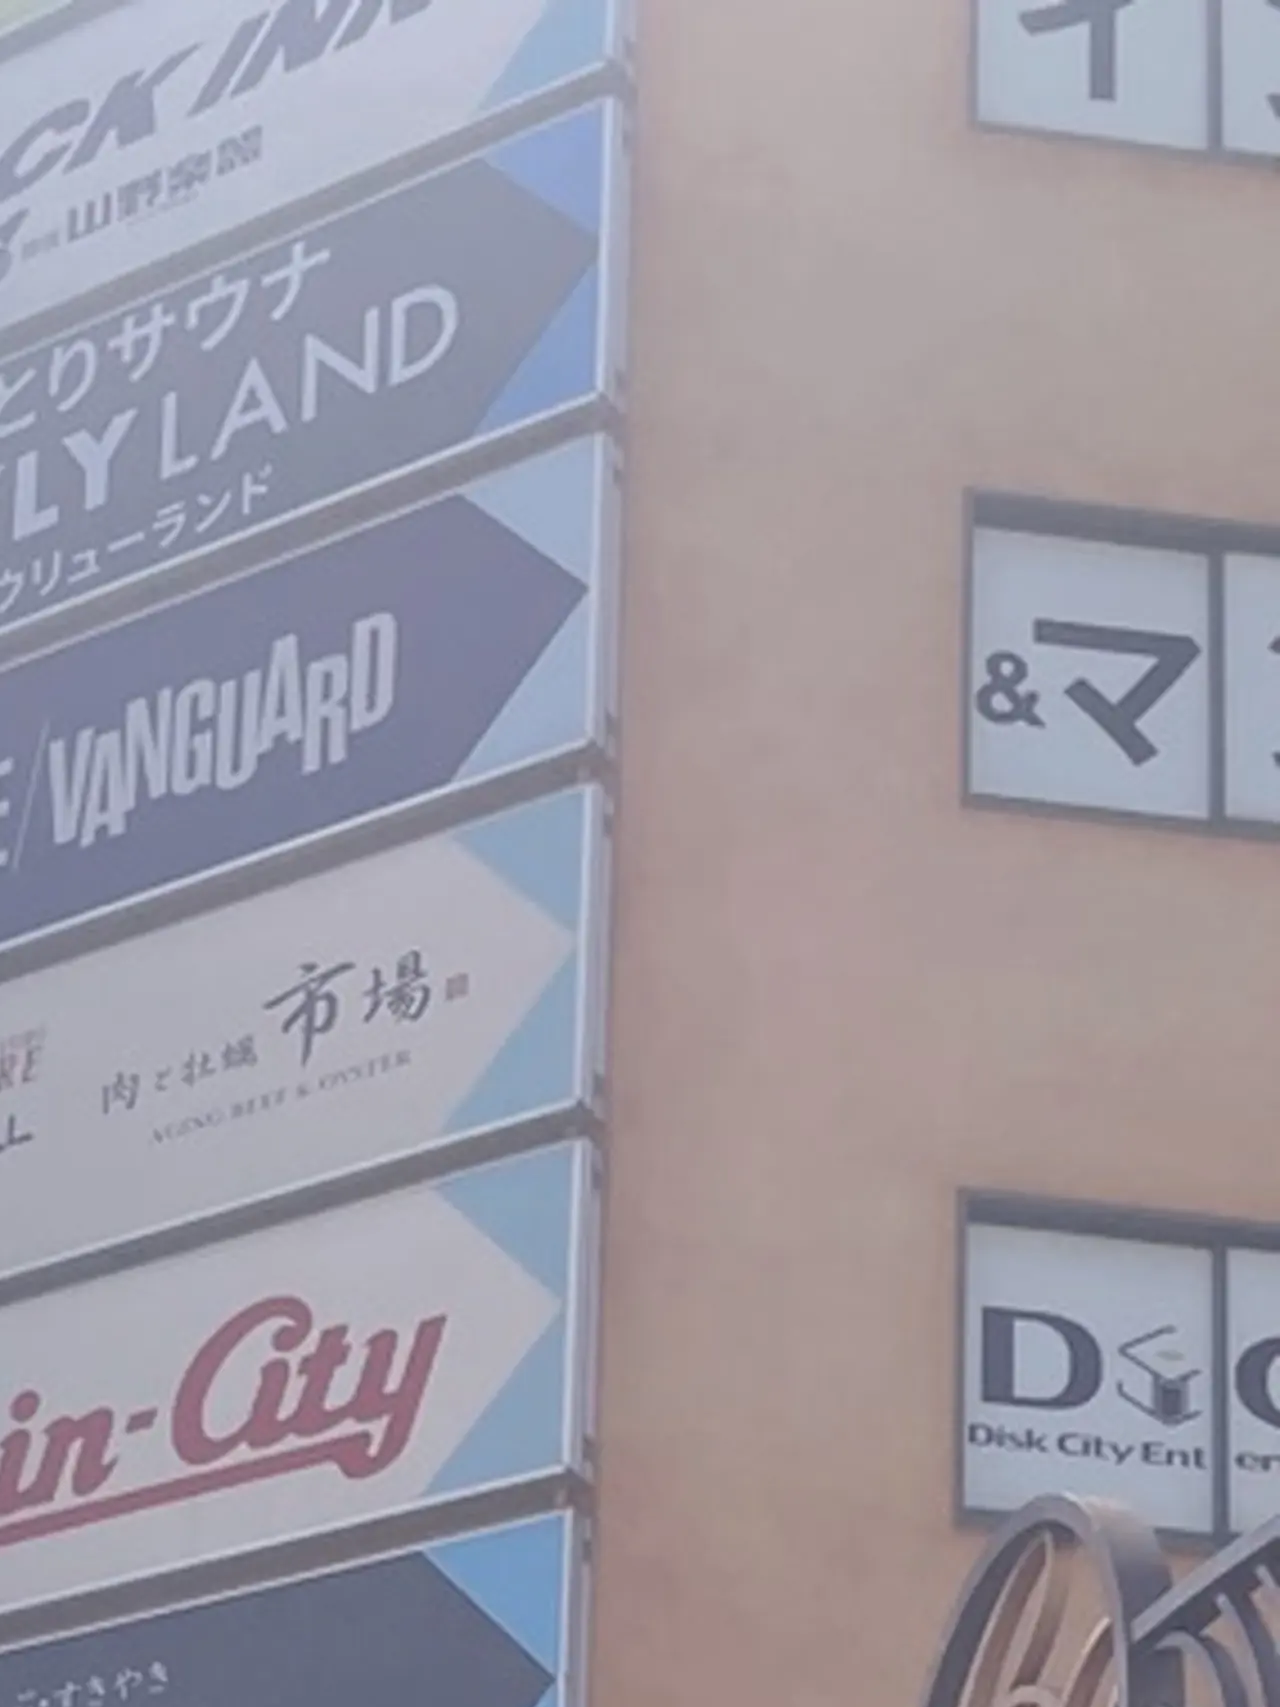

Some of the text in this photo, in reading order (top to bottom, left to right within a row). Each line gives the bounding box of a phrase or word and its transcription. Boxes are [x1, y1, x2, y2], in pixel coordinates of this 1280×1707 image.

[47, 611, 398, 850] VANGUARD
[967, 1422, 1047, 1454] Disk
[1056, 1431, 1136, 1467] City
